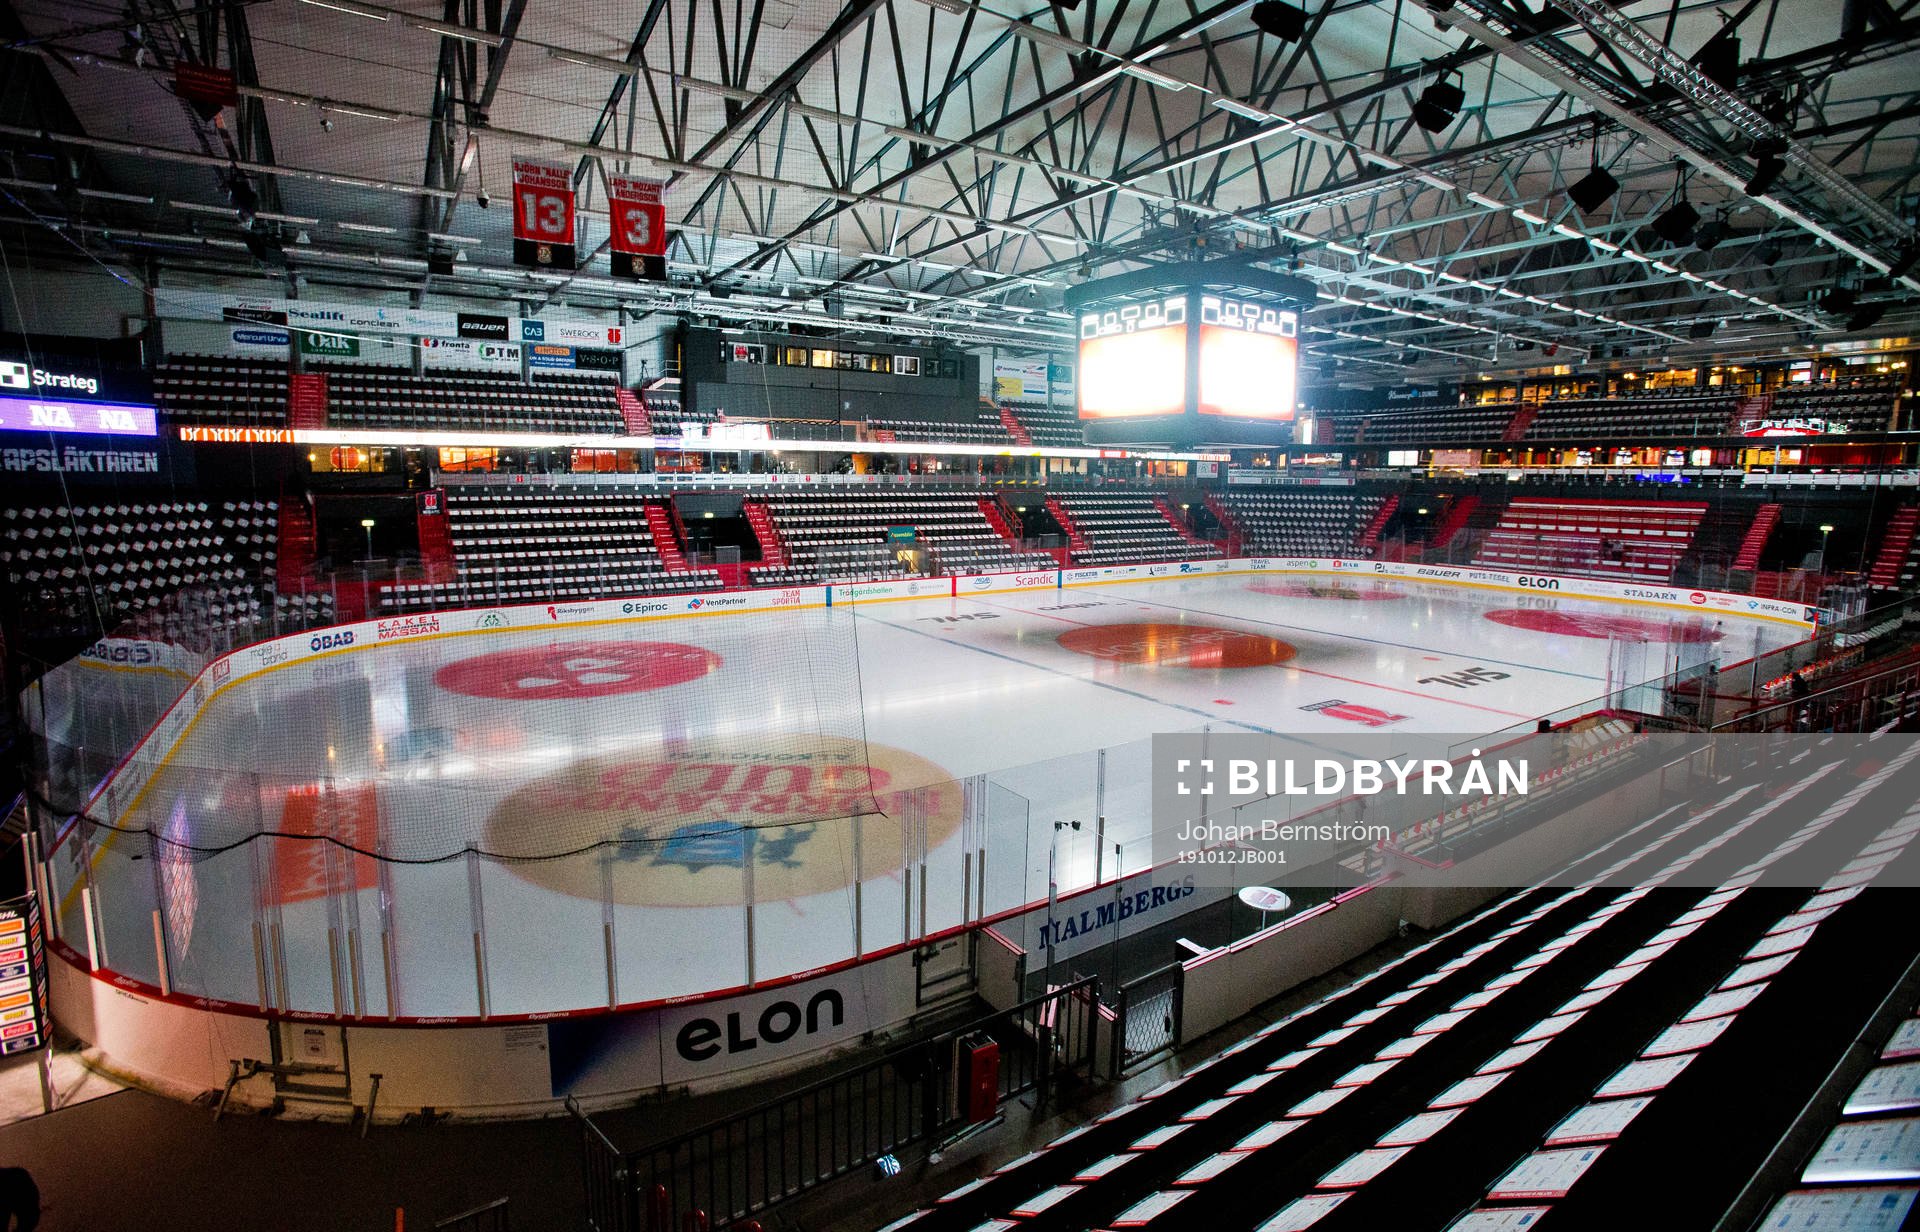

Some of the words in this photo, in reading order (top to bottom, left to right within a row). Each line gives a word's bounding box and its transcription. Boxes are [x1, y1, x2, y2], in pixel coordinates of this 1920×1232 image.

[522, 192, 566, 234] 13
[626, 209, 650, 246] 3
[288, 308, 345, 321] Sealift
[350, 319, 400, 328] conclean
[560, 328, 600, 338] SWEROCK
[308, 333, 350, 349] Oak
[441, 340, 470, 349] fronta
[485, 346, 519, 359] PTM
[32, 369, 98, 394] Strateg
[29, 405, 76, 428] NA
[97, 409, 138, 430] NA
[0, 446, 158, 472] APSLÄKTAREN
[1286, 560, 1309, 568] aspen
[1015, 573, 1054, 586] Scandic
[635, 602, 668, 614] Epiroc
[705, 597, 747, 607] VentPartner
[378, 615, 439, 629] KAKEL
[310, 631, 355, 652] ÖBAB
[1417, 667, 1512, 688] SHL
[1039, 874, 1195, 950] MALMBERGS
